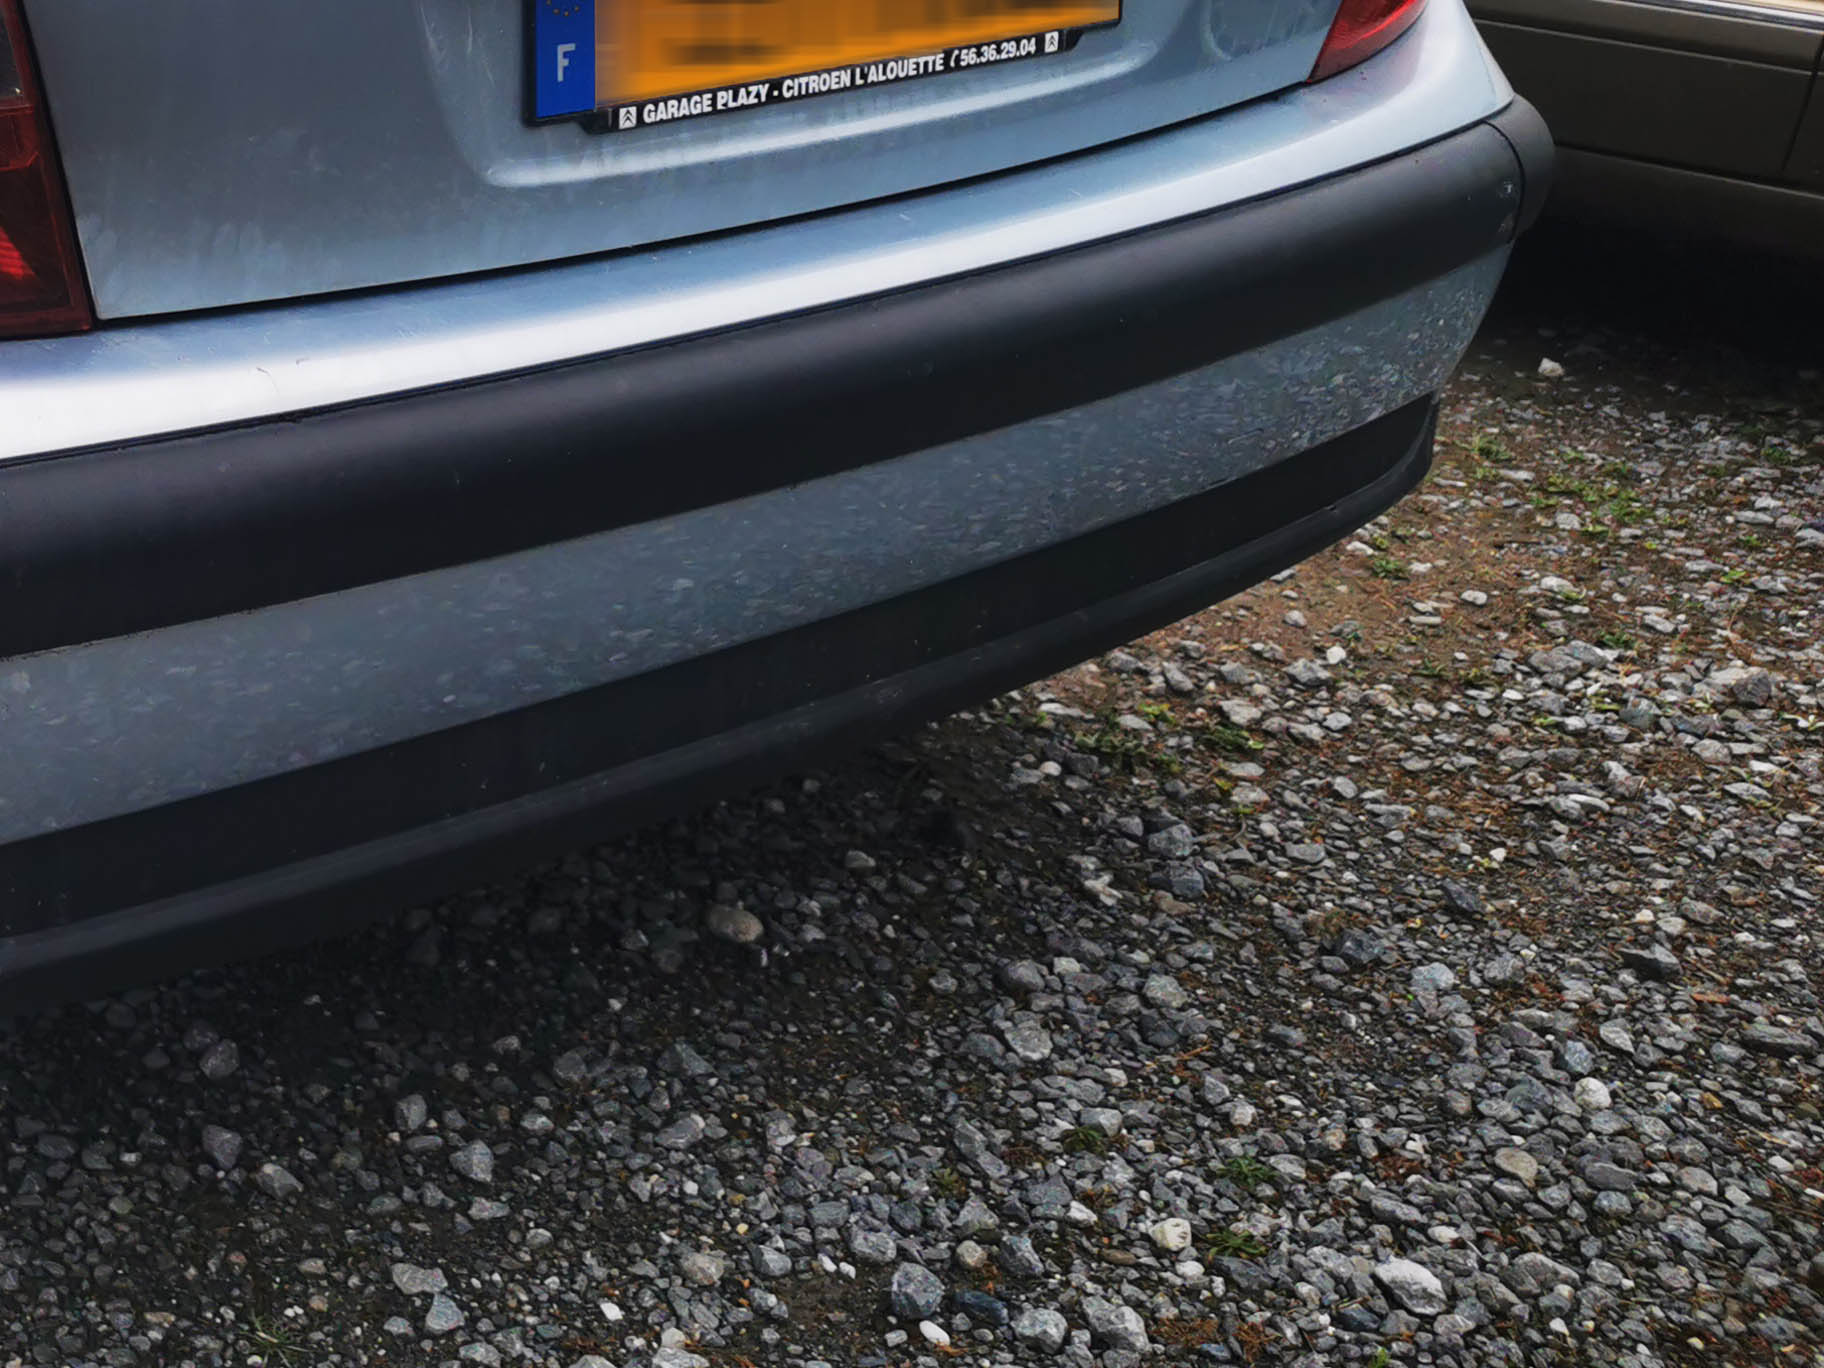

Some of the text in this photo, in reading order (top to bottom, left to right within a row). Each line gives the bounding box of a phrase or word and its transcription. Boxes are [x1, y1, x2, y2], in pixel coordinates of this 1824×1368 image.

[557, 43, 576, 82] F
[643, 93, 713, 123] GARAGE
[717, 83, 770, 110] PLAZY
[782, 69, 851, 98] CITROEN
[855, 53, 944, 86] L'ALOUETTE
[960, 37, 1037, 67] 56.36.29.04
